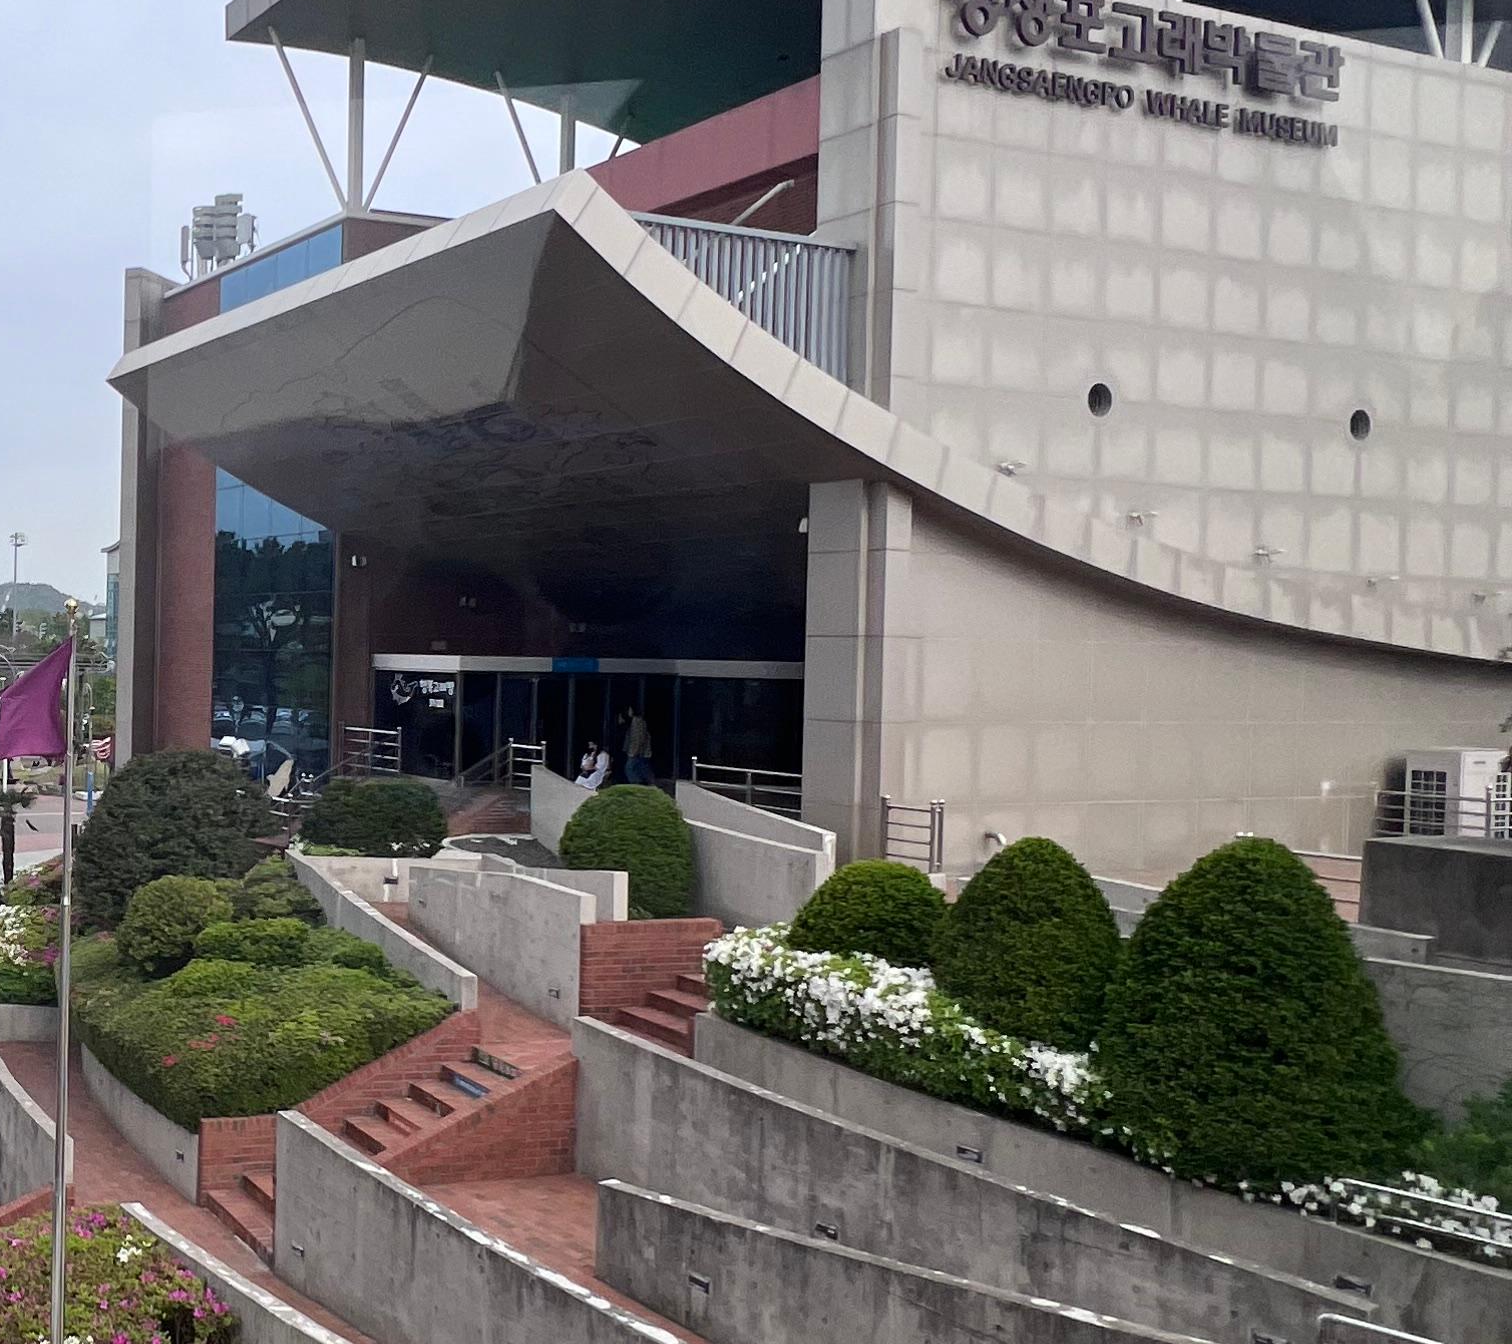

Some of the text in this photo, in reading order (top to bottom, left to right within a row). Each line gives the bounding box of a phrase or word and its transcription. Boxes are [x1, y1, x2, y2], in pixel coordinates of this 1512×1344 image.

[945, 52, 1339, 148] JANGSAENGPO WHALE MUSEUM
